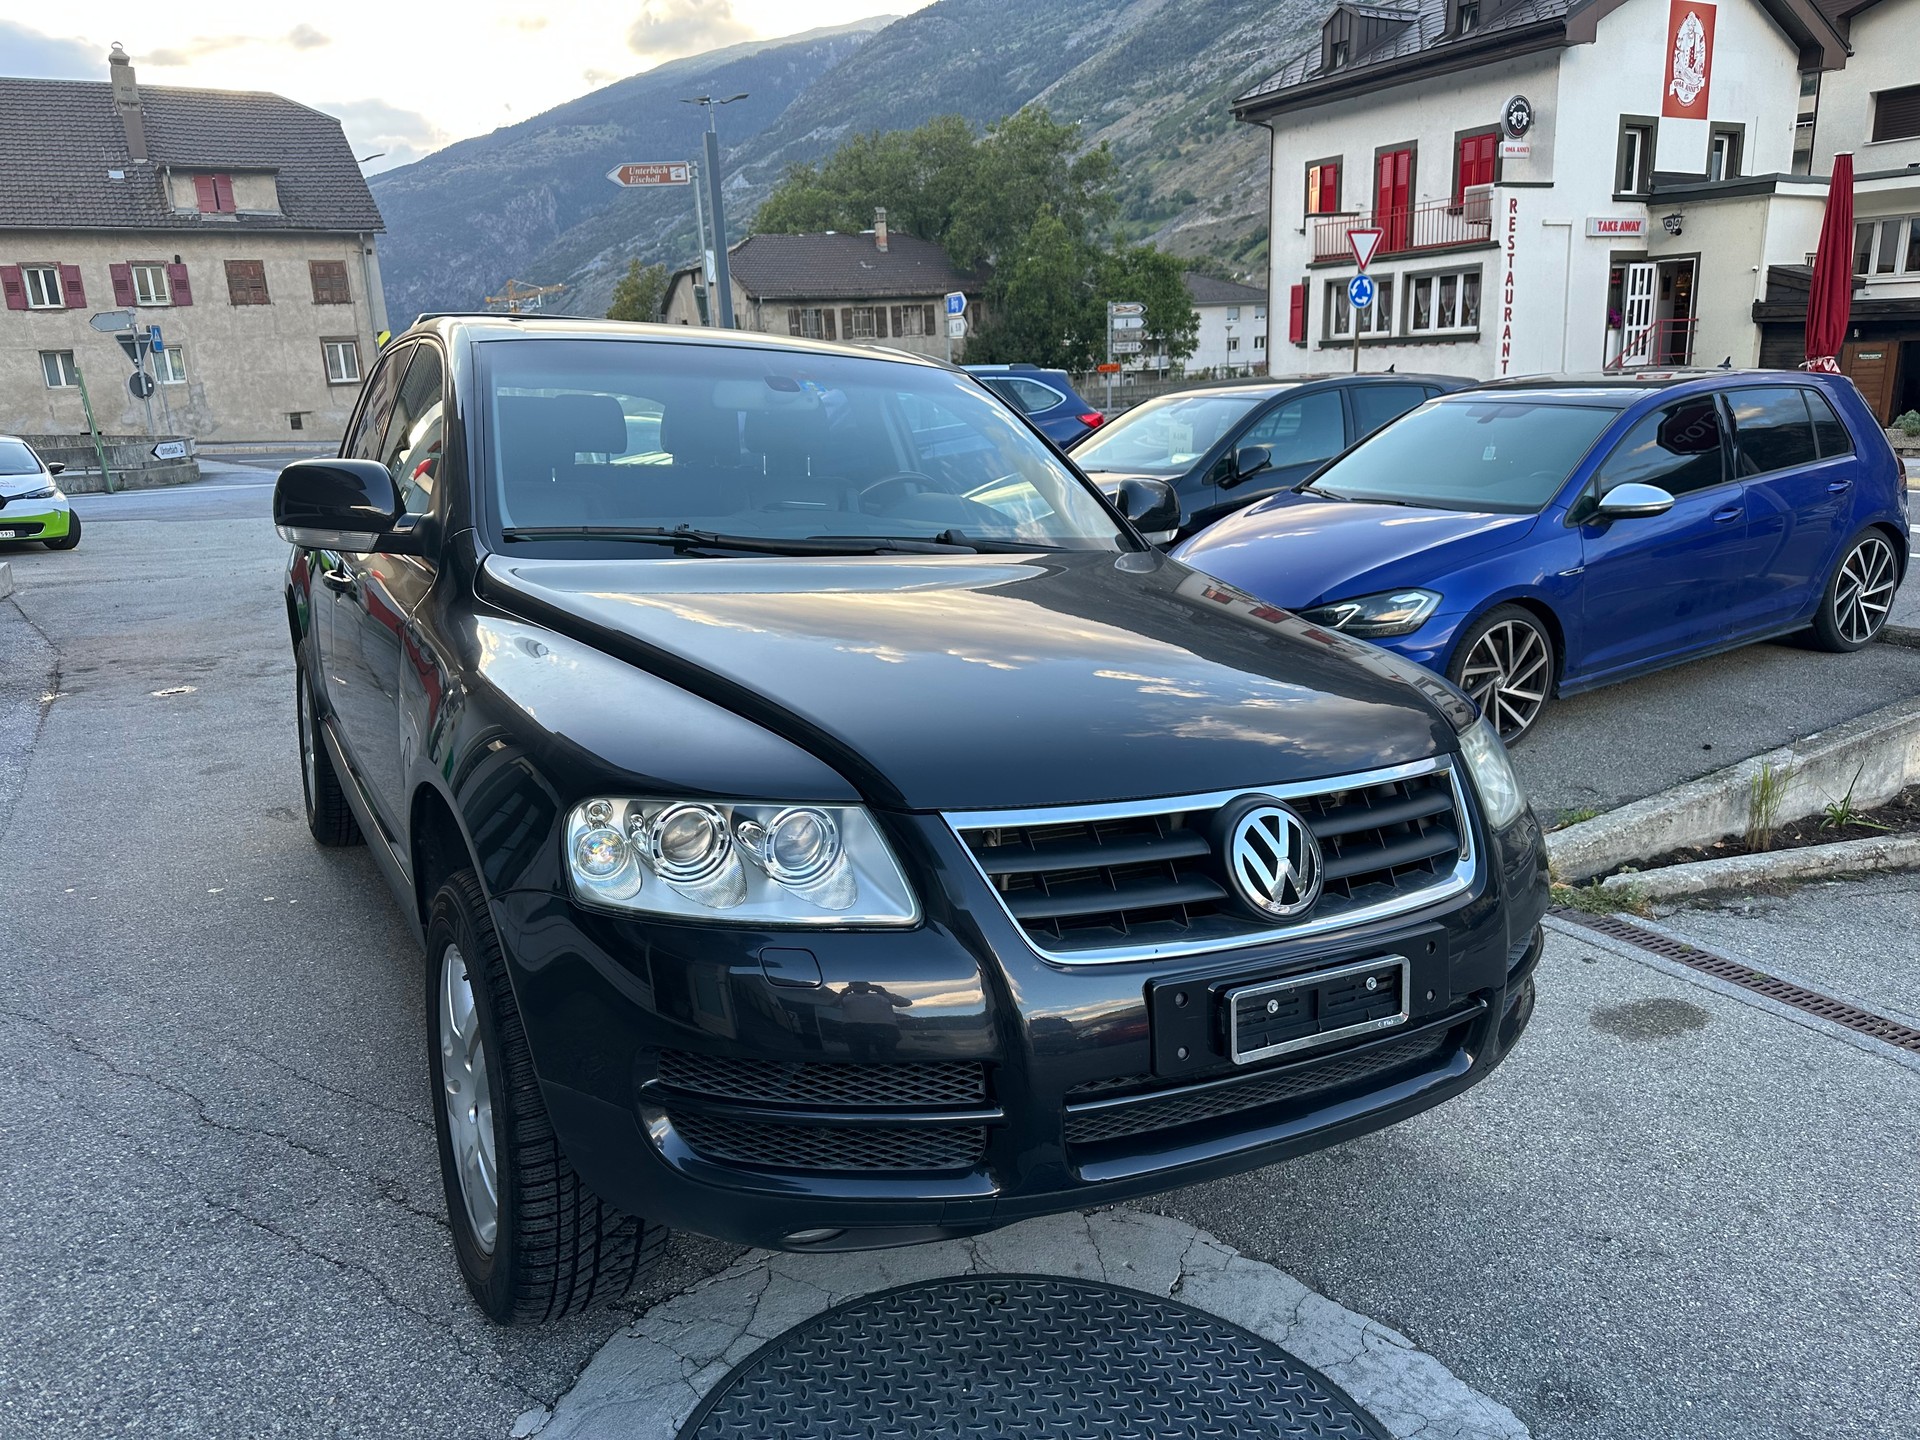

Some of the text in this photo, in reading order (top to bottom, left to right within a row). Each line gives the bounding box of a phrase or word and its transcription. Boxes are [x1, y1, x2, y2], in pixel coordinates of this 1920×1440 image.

[1674, 81, 1684, 89] OMA
[629, 165, 668, 175] Unterbäch
[629, 174, 660, 184] Eischoll
[1598, 220, 1641, 232] TAKE AWAY
[1501, 198, 1518, 375] RESTAURANT
